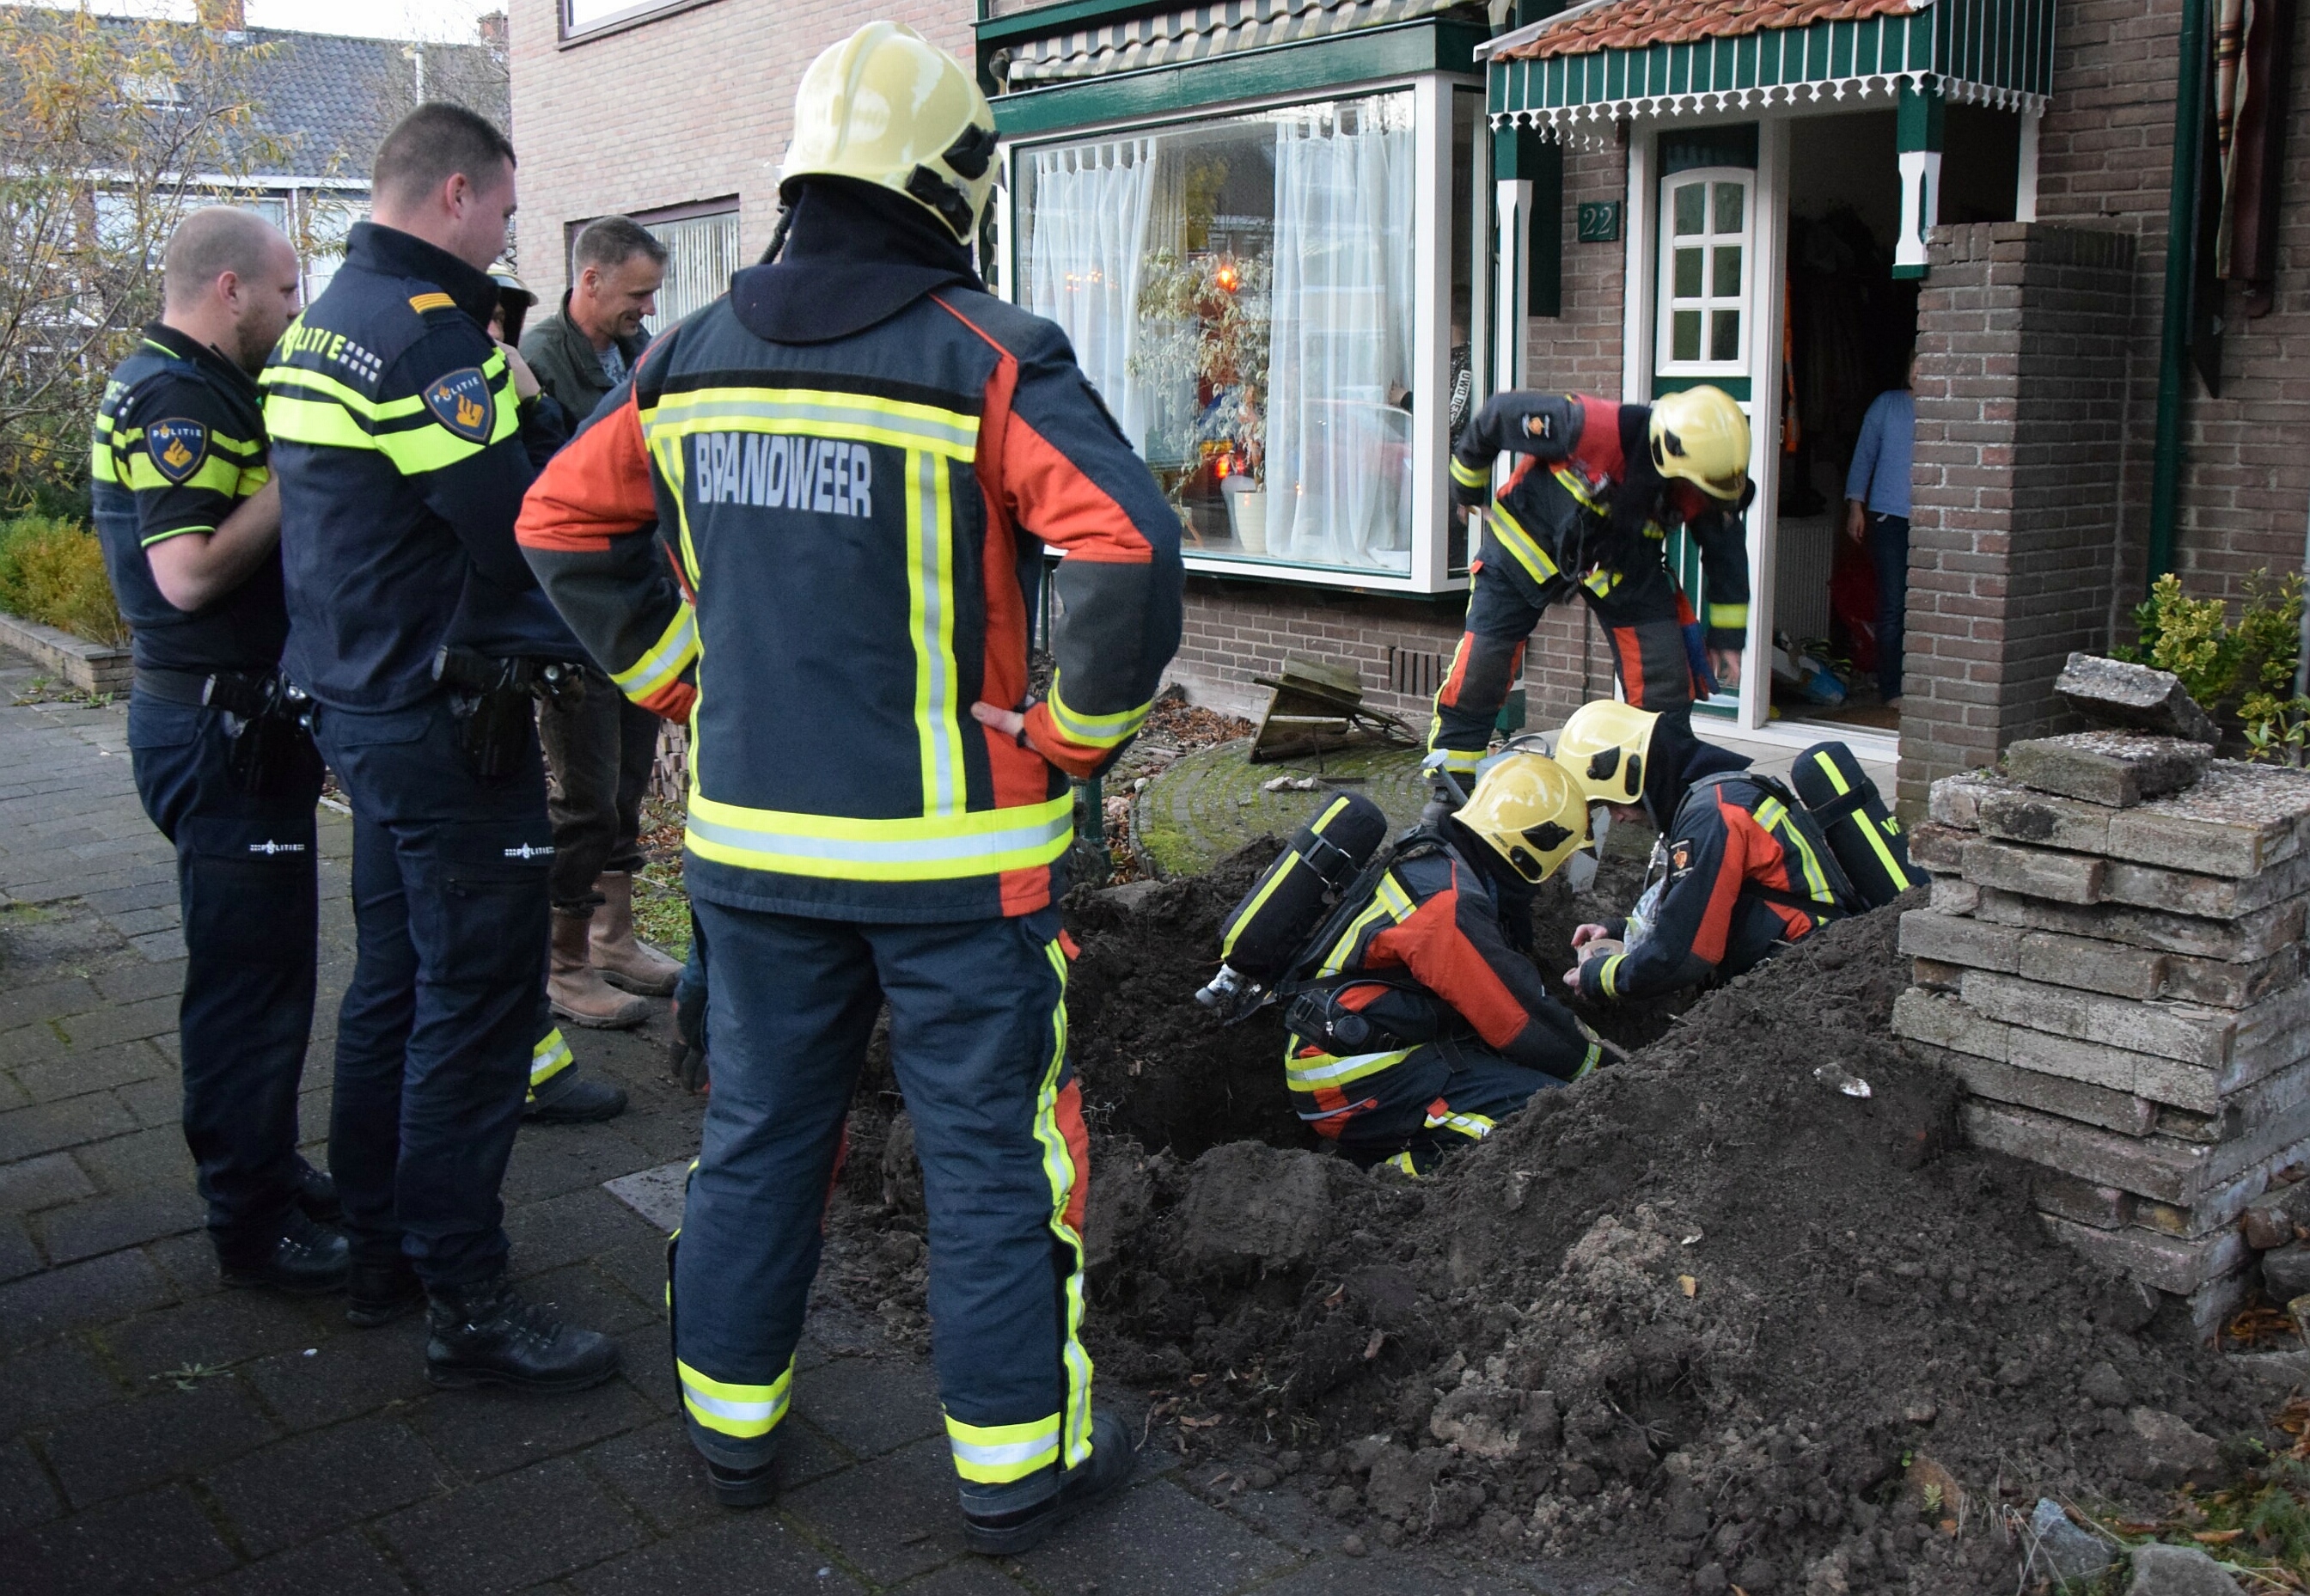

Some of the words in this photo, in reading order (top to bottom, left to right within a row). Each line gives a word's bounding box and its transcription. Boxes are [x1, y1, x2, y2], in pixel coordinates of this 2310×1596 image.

[1581, 207, 1613, 235] 22
[433, 376, 480, 404] POLITIE
[153, 428, 202, 439] POLITIE
[695, 431, 872, 518] BRANDWEER
[260, 842, 298, 854] POLITIE
